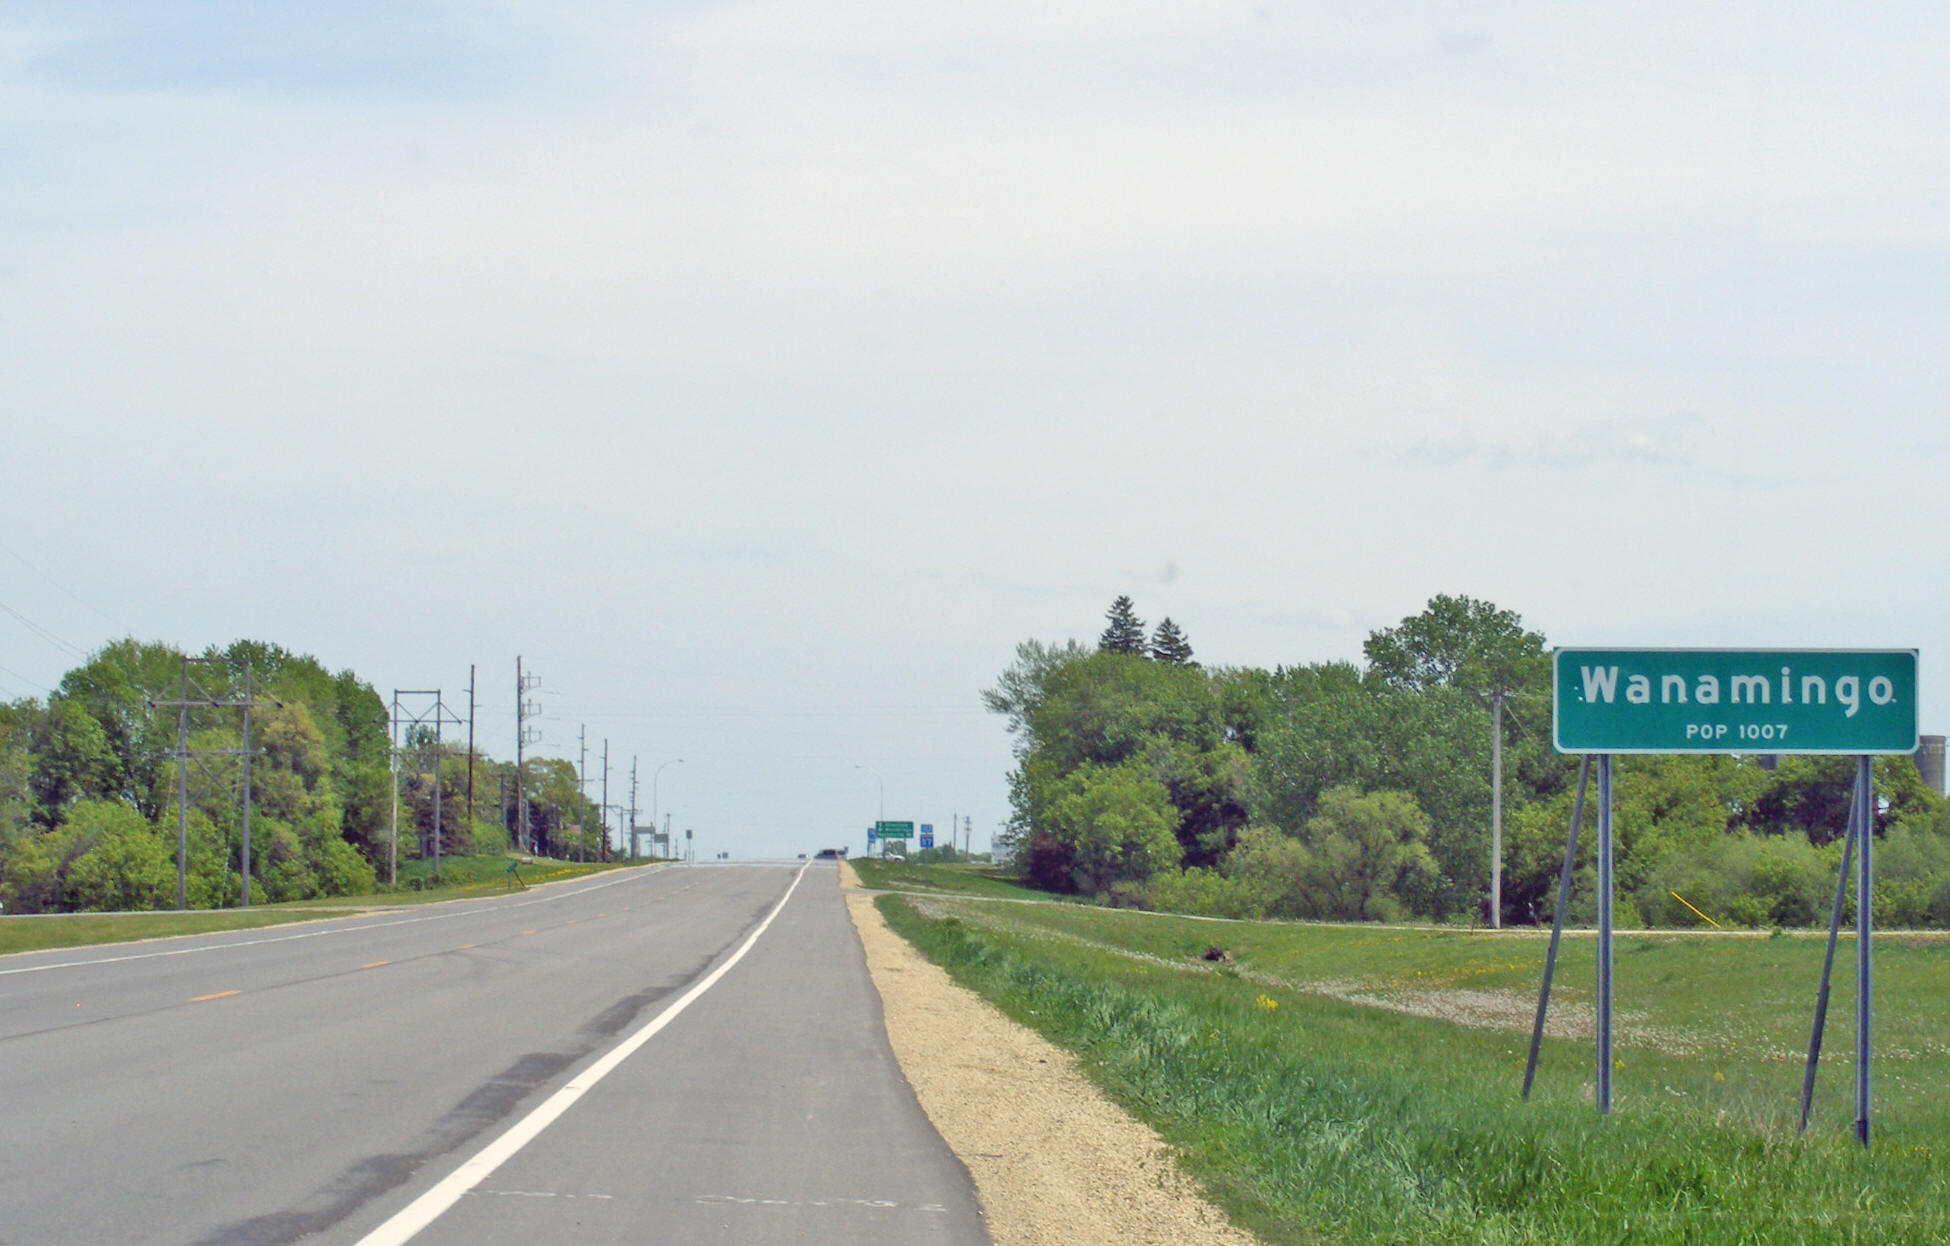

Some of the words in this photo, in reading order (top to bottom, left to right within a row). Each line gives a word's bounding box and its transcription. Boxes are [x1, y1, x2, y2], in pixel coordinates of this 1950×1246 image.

[1580, 666, 1893, 718] Wanamingo
[1686, 724, 1728, 739] POP
[1739, 724, 1788, 739] 1007
